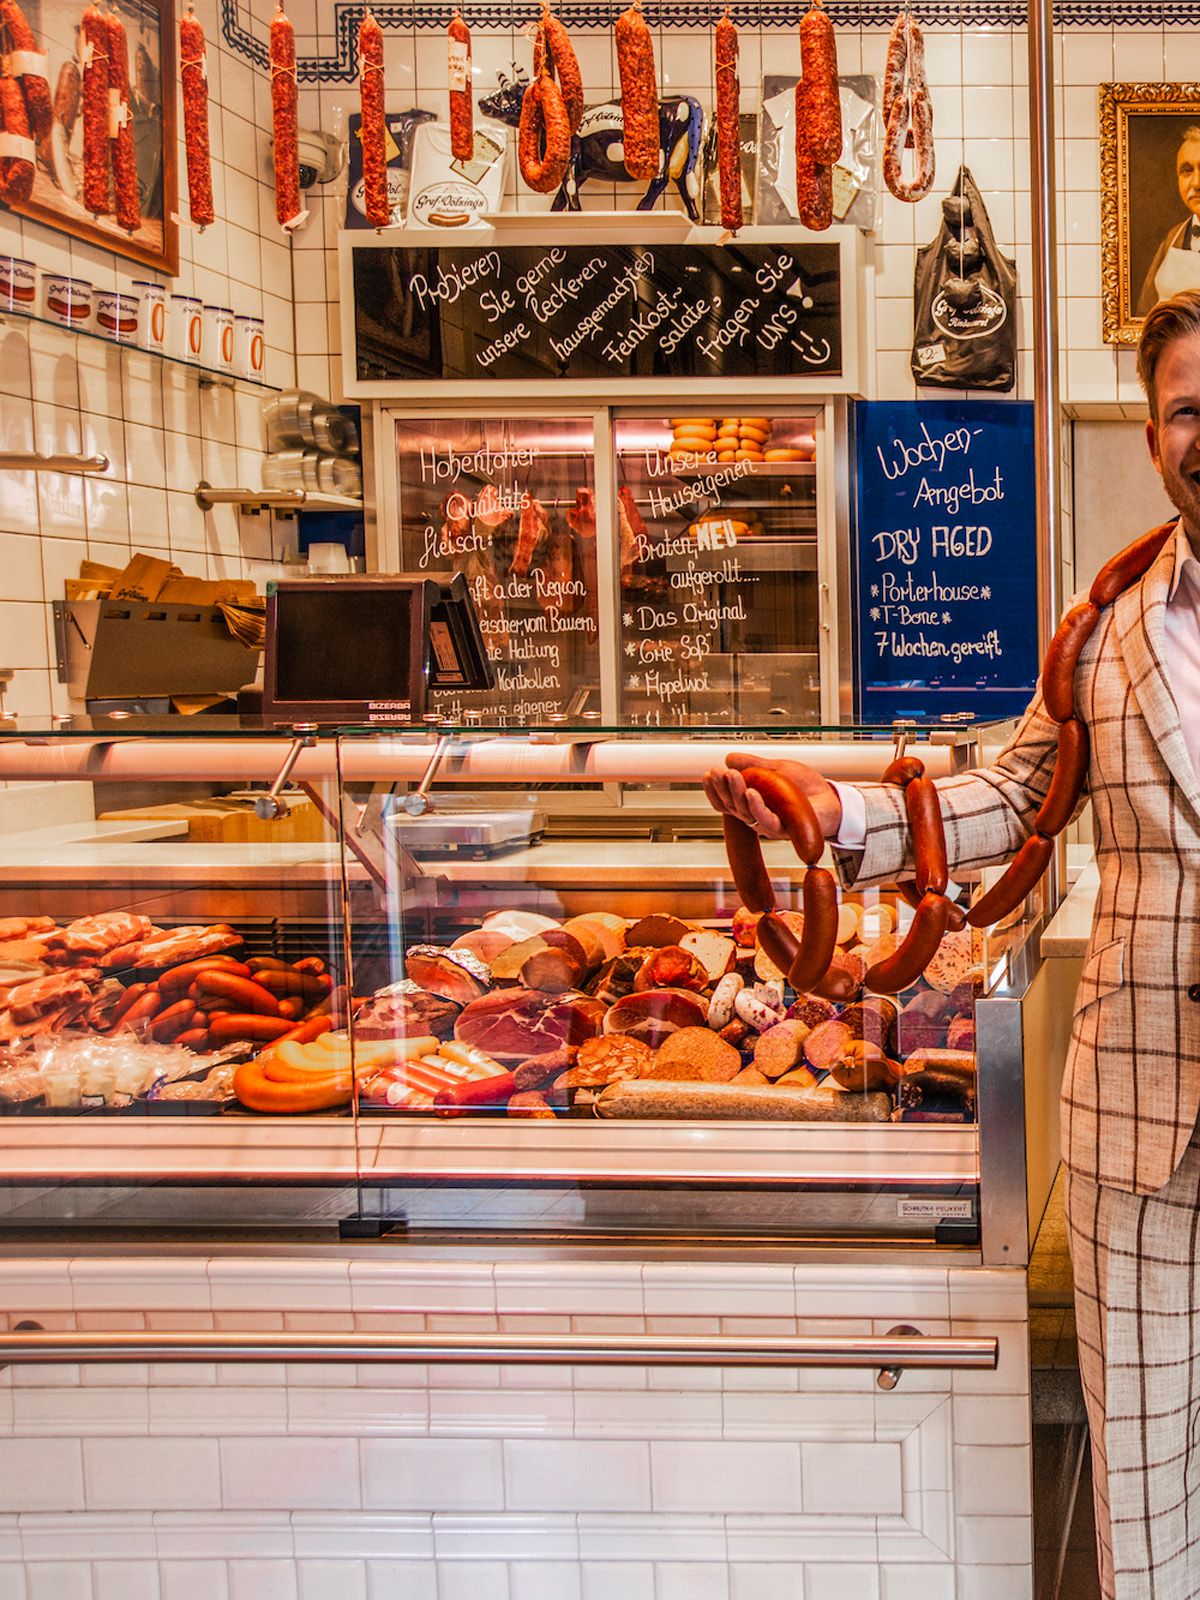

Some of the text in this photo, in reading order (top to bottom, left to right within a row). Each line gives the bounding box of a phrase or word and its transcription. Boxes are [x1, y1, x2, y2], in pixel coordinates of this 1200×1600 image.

[409, 251, 501, 311] Probieren
[480, 247, 567, 322] Sie gerne
[549, 251, 655, 361] hausgemachten
[697, 254, 793, 360] fragen Sie
[476, 323, 531, 366] unsere
[419, 440, 540, 484] Hohenloher
[645, 444, 718, 477] Unsere
[649, 457, 758, 519] Hauseigenen
[913, 466, 1005, 515] Angebot
[696, 518, 737, 552] NEU
[872, 526, 993, 565] DRY AGED
[508, 573, 533, 598] der
[531, 568, 587, 607] Region
[524, 615, 548, 633] vom
[545, 606, 597, 633] Bauern
[637, 595, 747, 631] Das Original
[509, 637, 560, 668] Haltung
[874, 629, 1002, 664] 7 Wochen gereift
[497, 665, 561, 691] Kontrollen
[368, 702, 411, 710] BIZERBA
